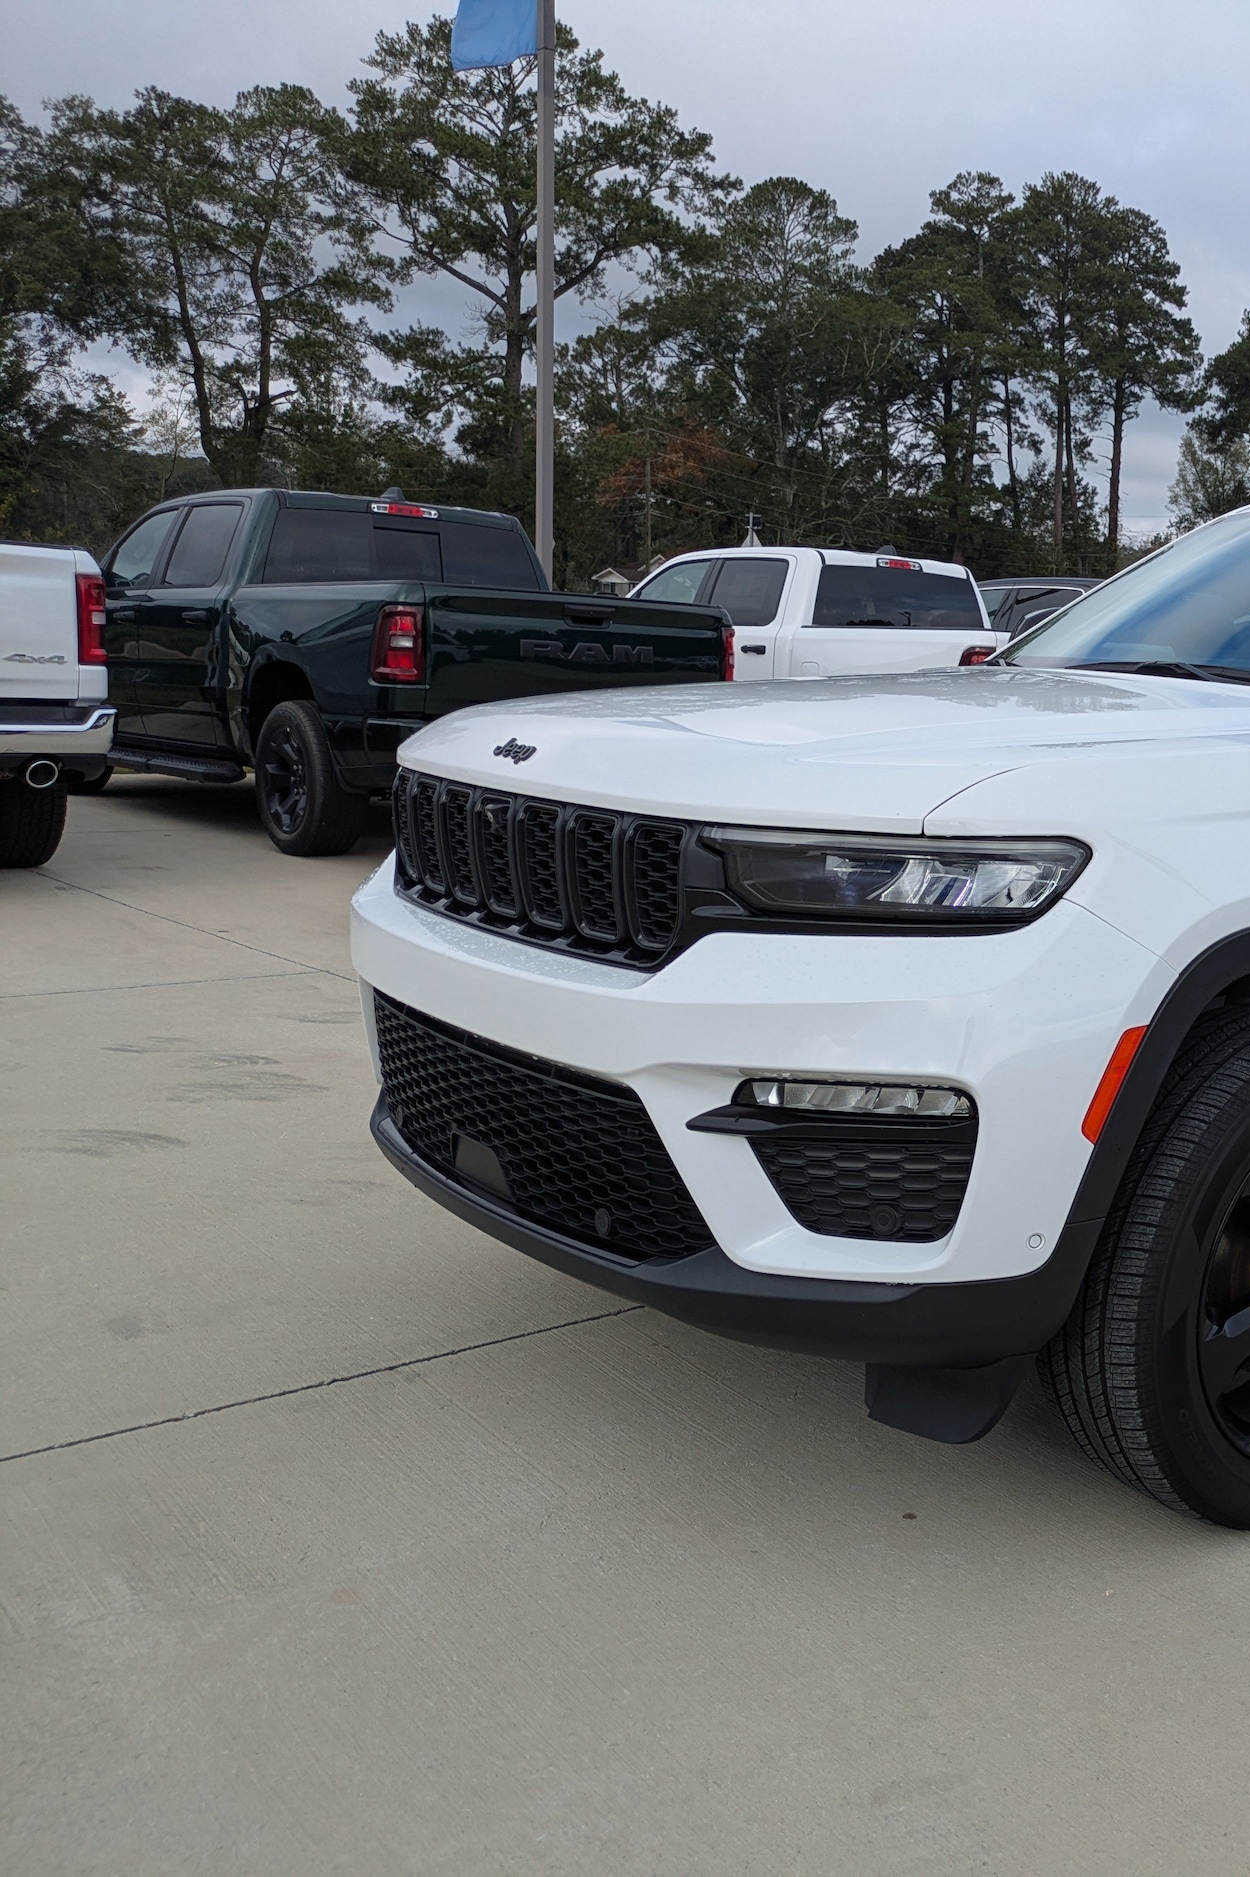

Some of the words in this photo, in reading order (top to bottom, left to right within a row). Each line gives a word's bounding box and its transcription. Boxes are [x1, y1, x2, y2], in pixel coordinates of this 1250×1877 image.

[2, 653, 68, 665] 4x4
[520, 638, 653, 664] RAM
[493, 737, 537, 764] Jeep
